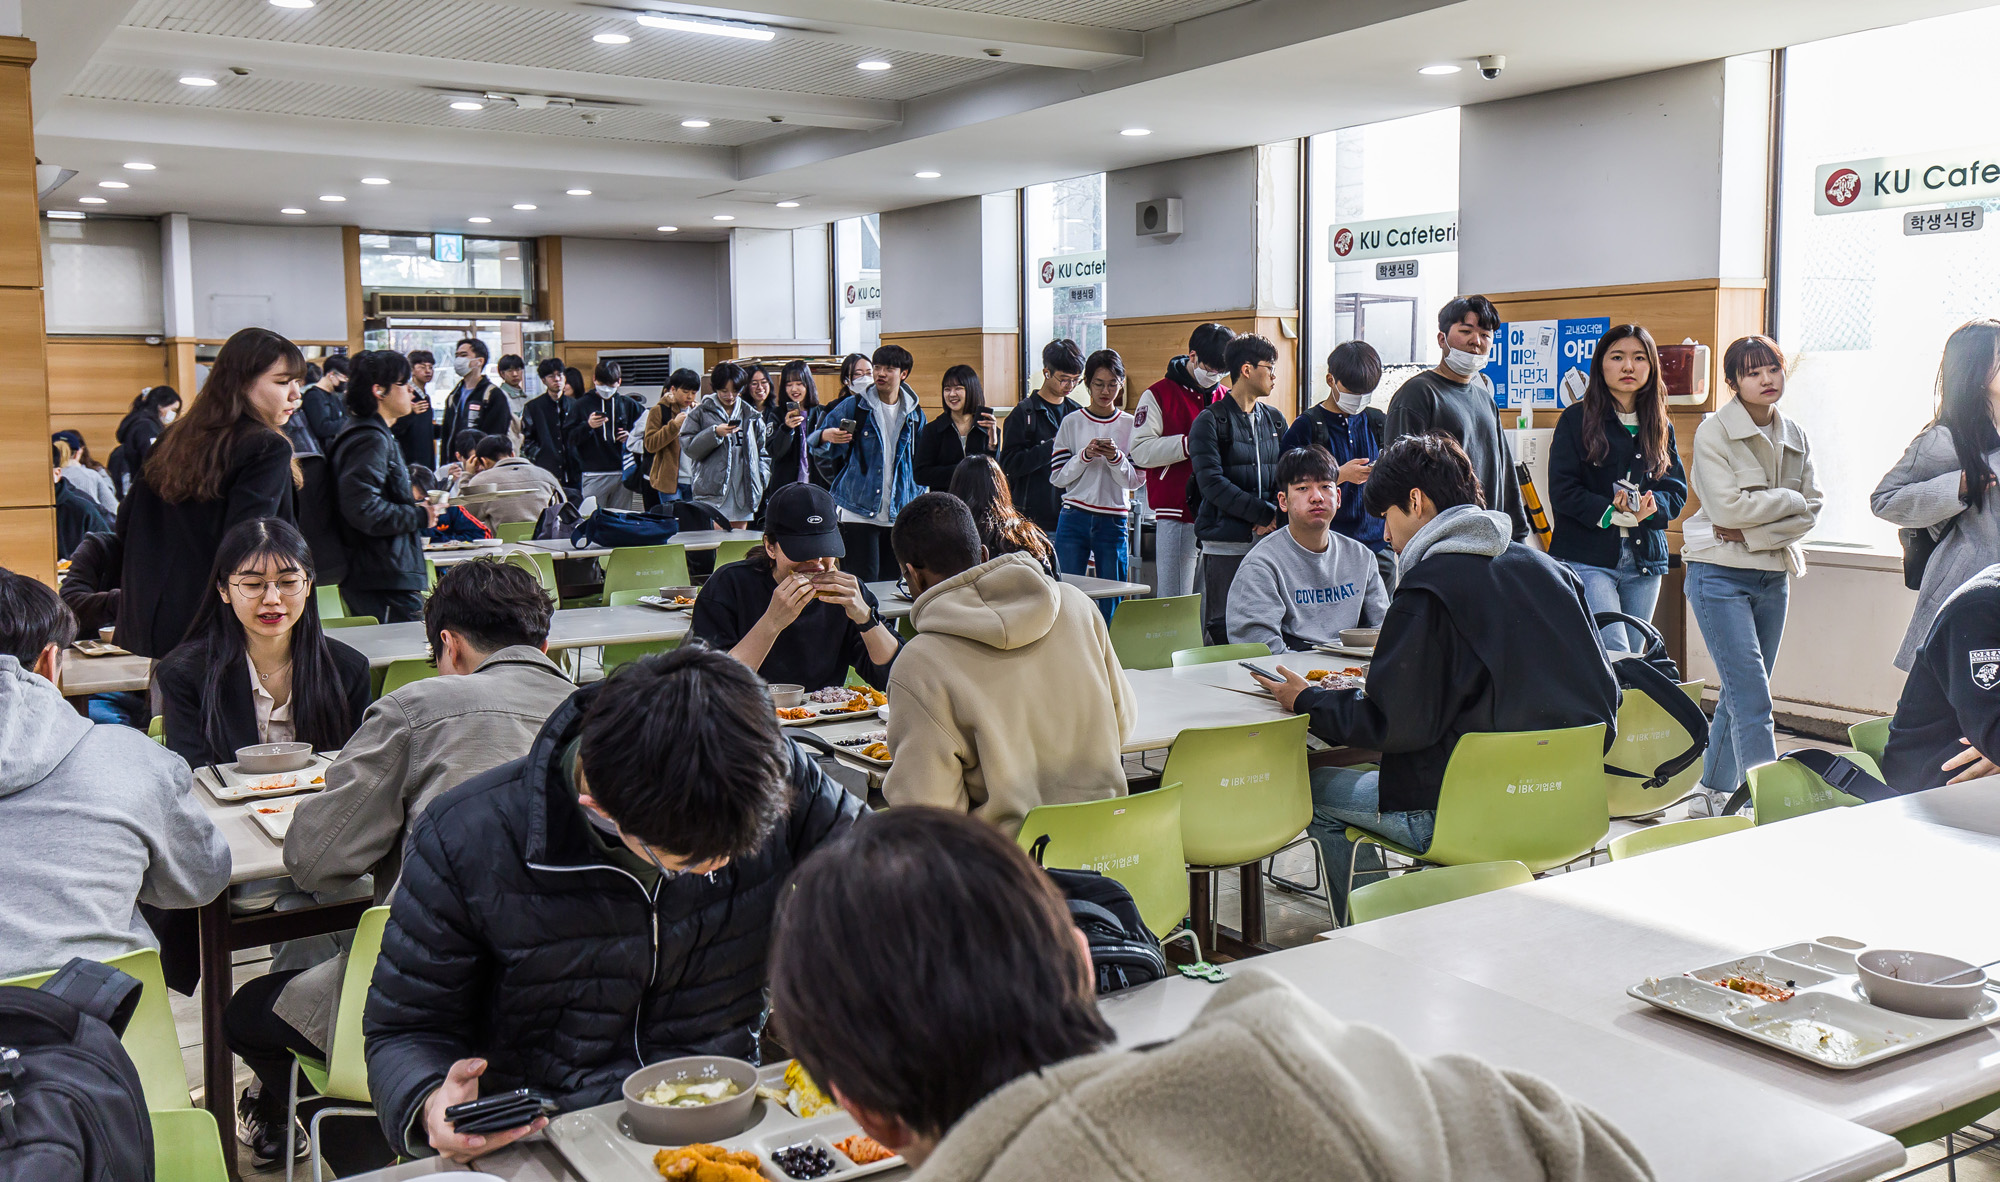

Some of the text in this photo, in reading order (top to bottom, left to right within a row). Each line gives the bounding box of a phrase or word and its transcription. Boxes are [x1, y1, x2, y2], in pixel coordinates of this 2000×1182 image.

[1873, 160, 2000, 197] KU Cafe
[1910, 209, 1976, 232] 학생식당
[1360, 222, 1459, 250] KU Cafeteri
[1058, 259, 1106, 279] KU Cafet
[1379, 262, 1415, 278] 학생식당
[858, 287, 868, 300] KU
[1071, 288, 1094, 301] 학생식당
[1511, 329, 1525, 346] 야
[1564, 324, 1603, 335] 교내오더앱
[1511, 368, 1548, 385] 나먼저
[1511, 387, 1537, 404] 간다
[1231, 777, 1245, 786] IBK
[1518, 784, 1534, 794] IBK
[1535, 781, 1562, 792] 기업은행
[1093, 861, 1110, 873] IBK
[1112, 854, 1140, 869] 기업은행
